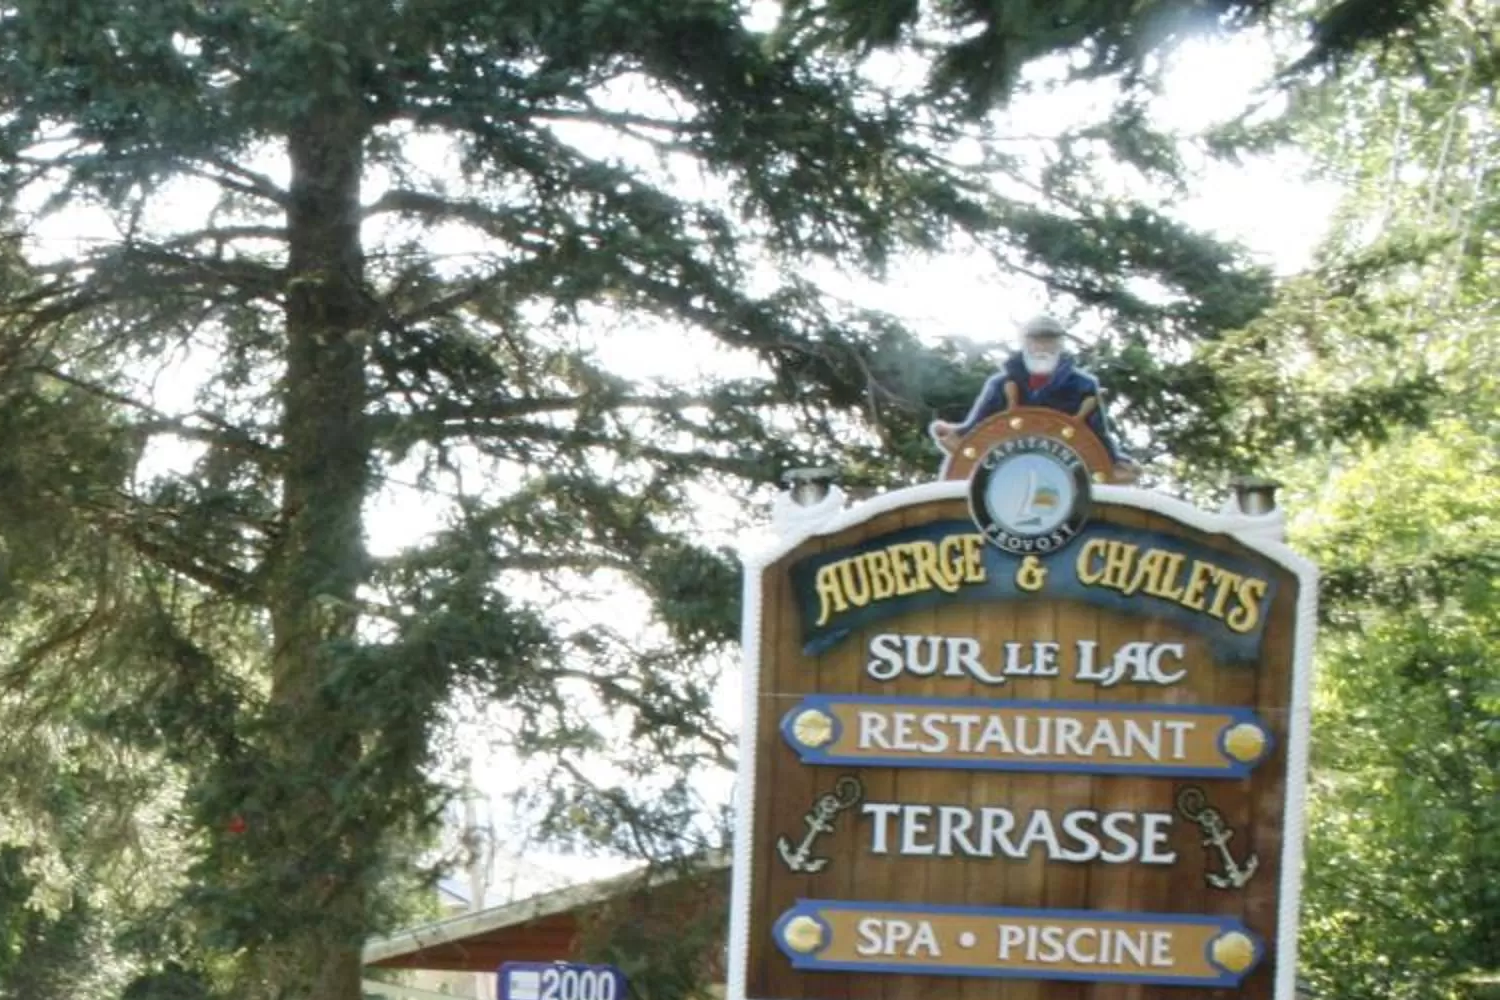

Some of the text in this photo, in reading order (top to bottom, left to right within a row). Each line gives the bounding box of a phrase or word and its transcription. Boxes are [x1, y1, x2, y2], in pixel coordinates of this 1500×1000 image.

[981, 437, 1082, 470] CAPITAINE
[986, 523, 1075, 551] PROVOST
[815, 532, 1268, 633] AUBERGE & CHALETS
[867, 633, 1186, 685] SUR LE LAC
[857, 710, 1195, 760] RESTAURANT
[861, 802, 1177, 865] TERRASSE
[855, 918, 1175, 967] SPA PISCINE
